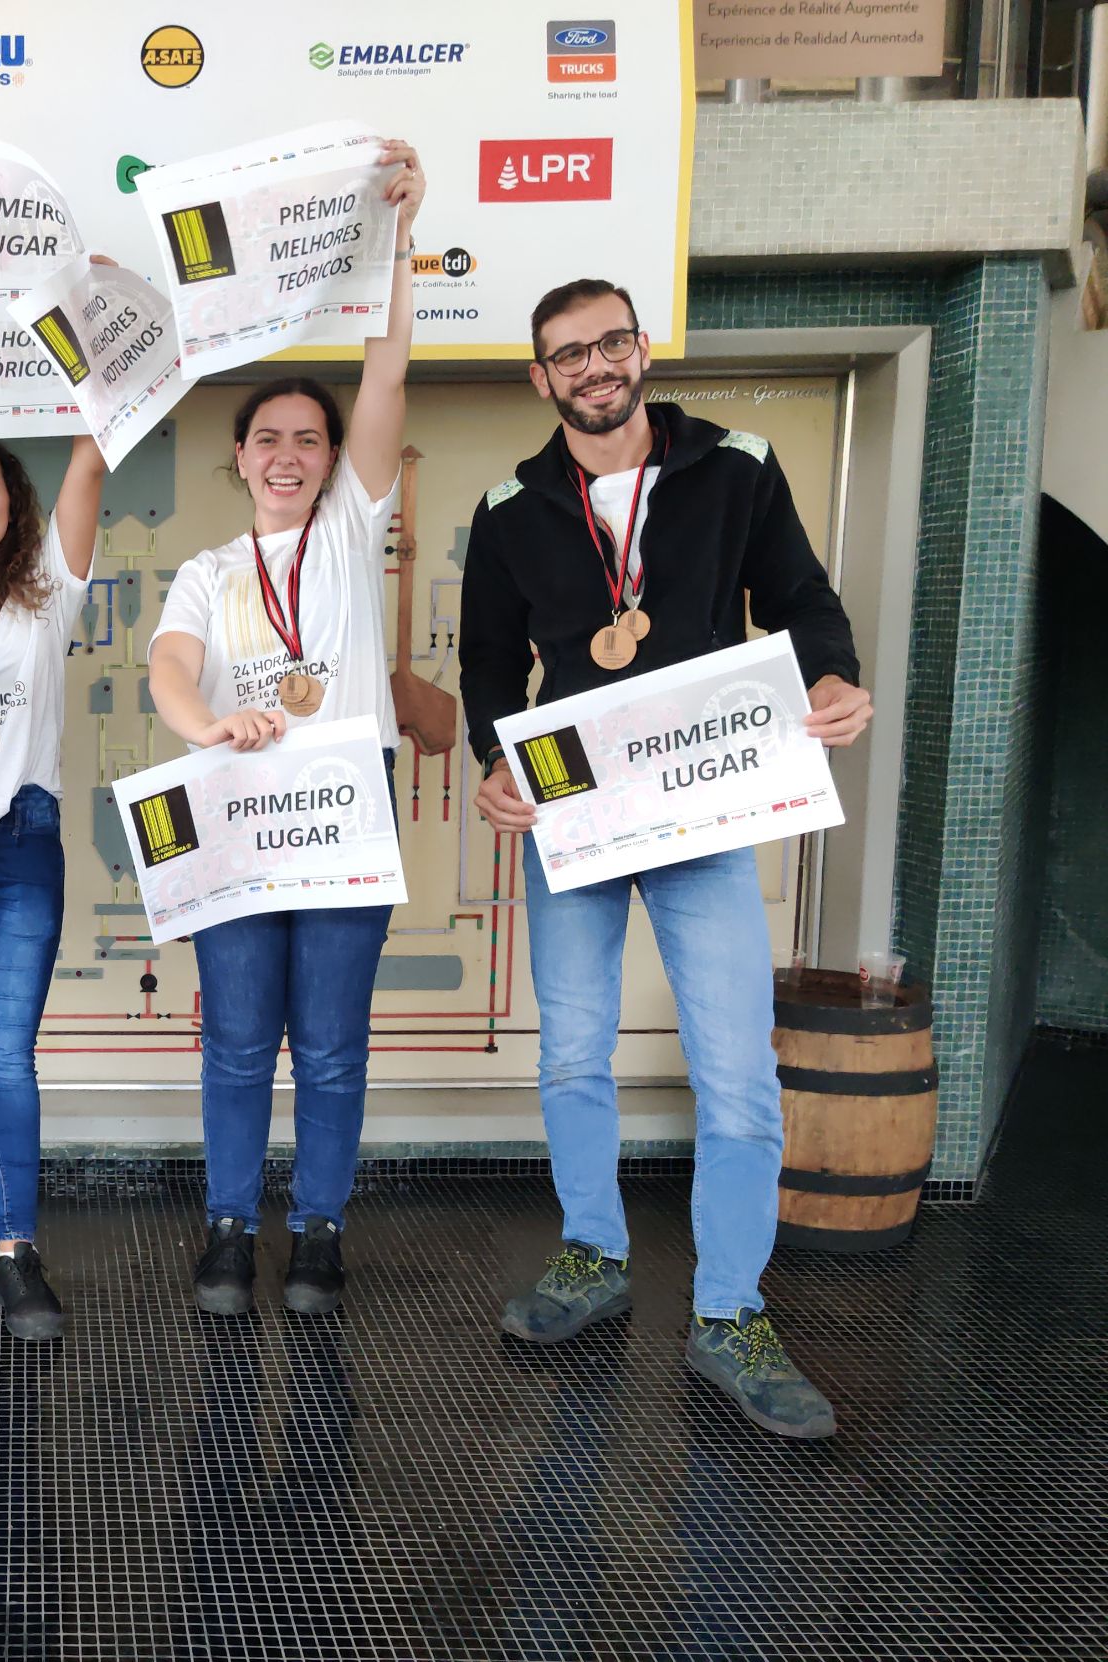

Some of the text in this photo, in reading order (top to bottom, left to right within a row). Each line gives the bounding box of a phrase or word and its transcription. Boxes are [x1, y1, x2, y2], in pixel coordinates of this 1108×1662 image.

[707, 1, 919, 19] Expérience de Réalité Augmentée
[565, 30, 598, 44] Ford
[700, 30, 924, 48] Experiencia de Realidad Aumentada
[374, 67, 383, 76] de
[385, 66, 432, 77] Embalagem
[559, 63, 604, 75] TRUCKS
[547, 90, 618, 101] Sharing the load
[522, 153, 591, 183] LPR
[279, 193, 356, 226] PRÉMIO
[269, 222, 363, 263] MELHORES
[277, 254, 354, 293] TEÓRICOS
[411, 254, 468, 274] que tdi
[422, 280, 462, 288] Codificação
[413, 309, 479, 320] OMINO
[101, 320, 164, 389] NOTURNOS
[647, 386, 737, 403] Instrument
[232, 652, 293, 680] 24 HORA
[236, 680, 255, 697] DE
[10, 697, 28, 708] 022
[627, 704, 772, 763] PRIMEIRO
[662, 747, 760, 792] LUGAR
[226, 784, 355, 822] PRIMEIRO
[256, 824, 340, 851] LUGAR
